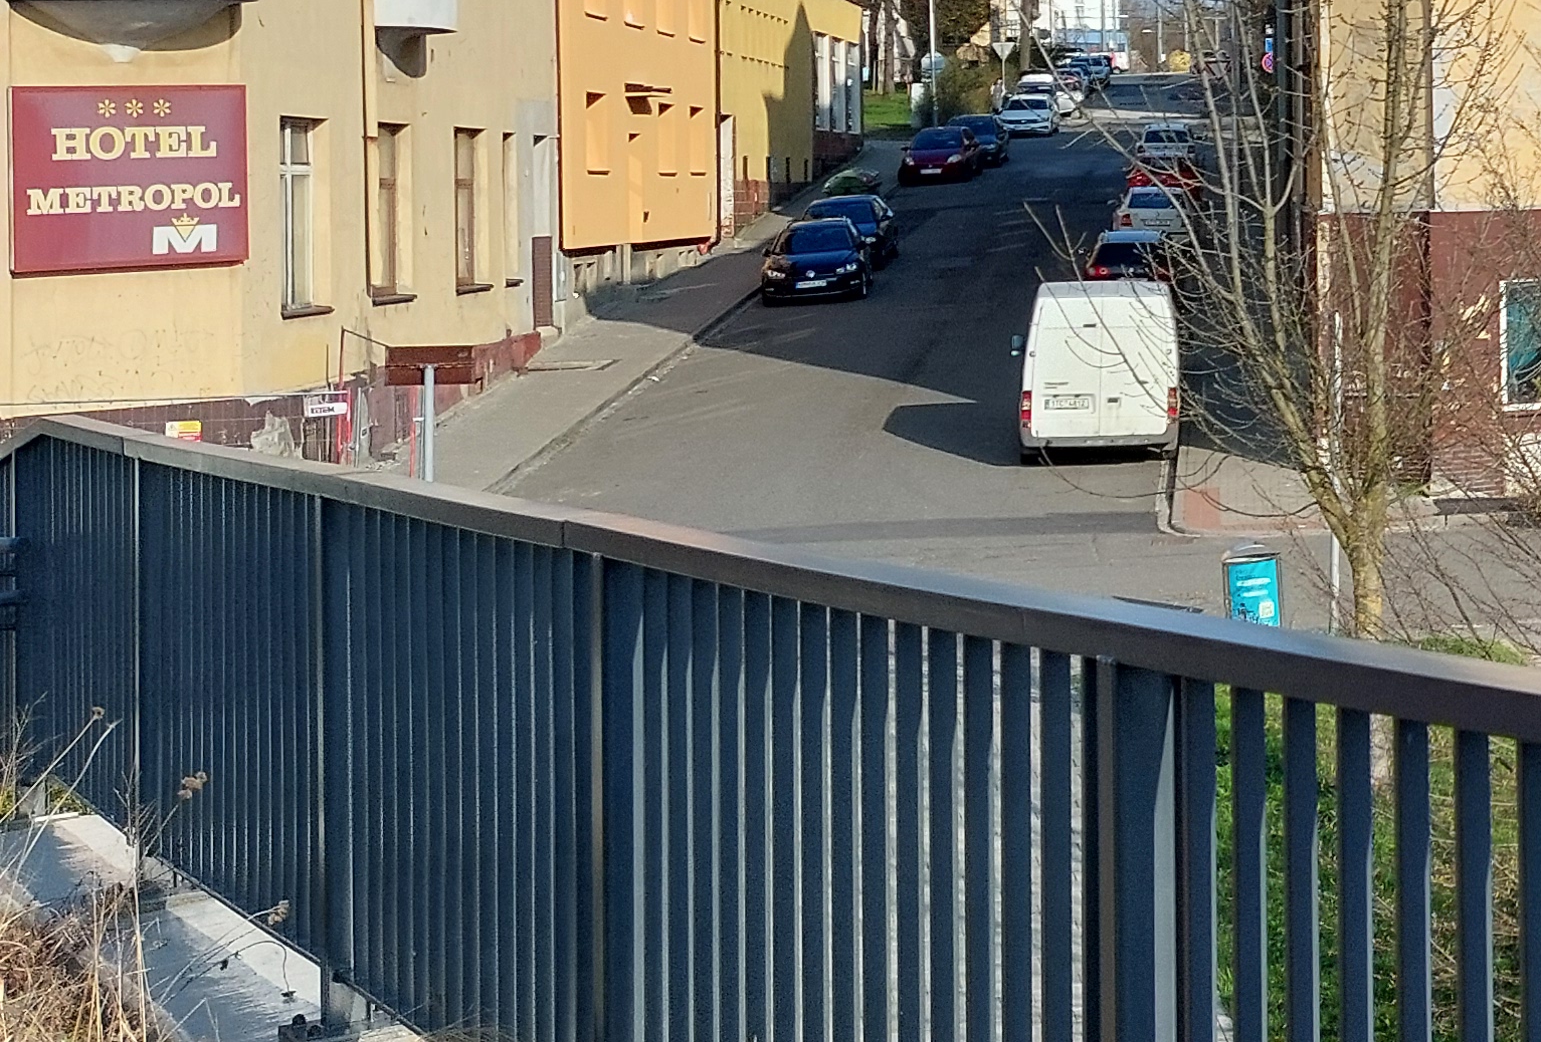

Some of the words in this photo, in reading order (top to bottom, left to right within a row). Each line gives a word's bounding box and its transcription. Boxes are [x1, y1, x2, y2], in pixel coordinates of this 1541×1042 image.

[51, 126, 217, 160] HOTEL
[26, 182, 241, 215] METROPOL
[152, 223, 217, 254] M
